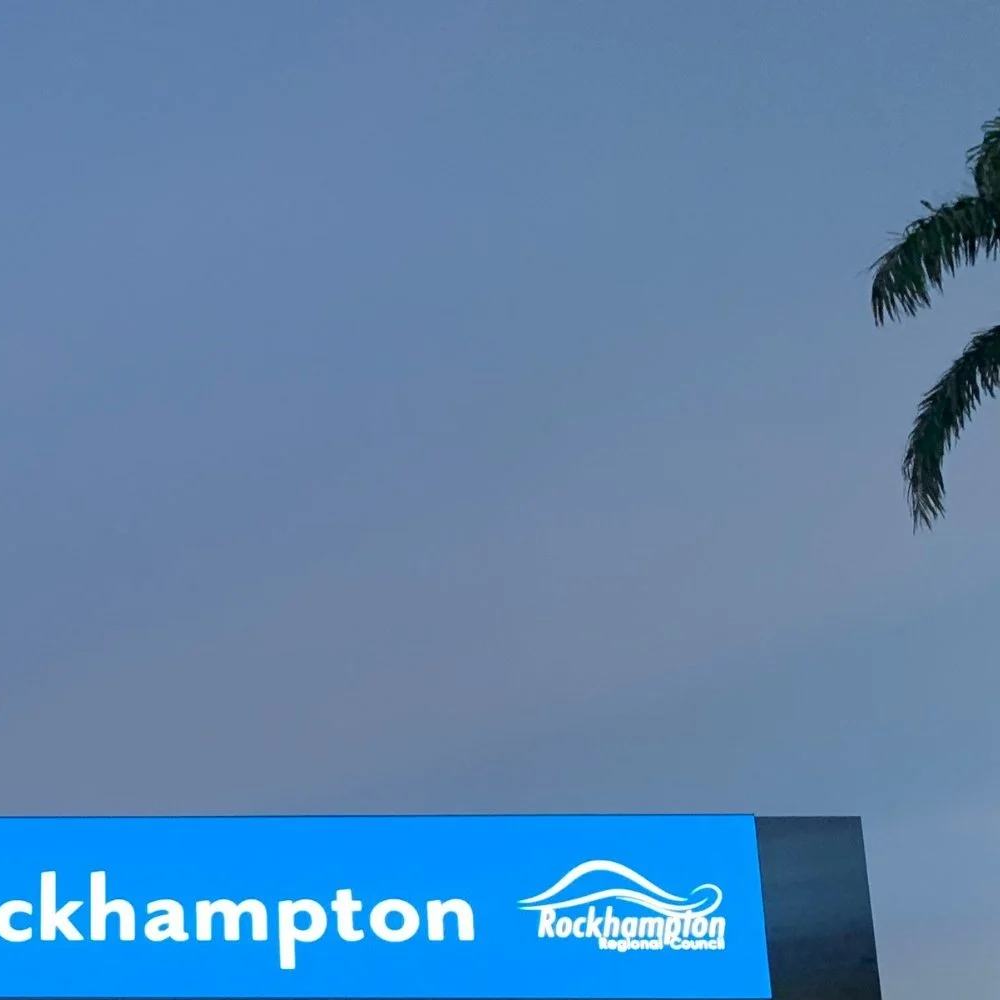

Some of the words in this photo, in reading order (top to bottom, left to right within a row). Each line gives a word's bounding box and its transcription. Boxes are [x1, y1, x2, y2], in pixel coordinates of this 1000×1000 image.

[537, 906, 726, 944] Rockhampton
[599, 937, 663, 953] Regional
[669, 937, 726, 951] Council
